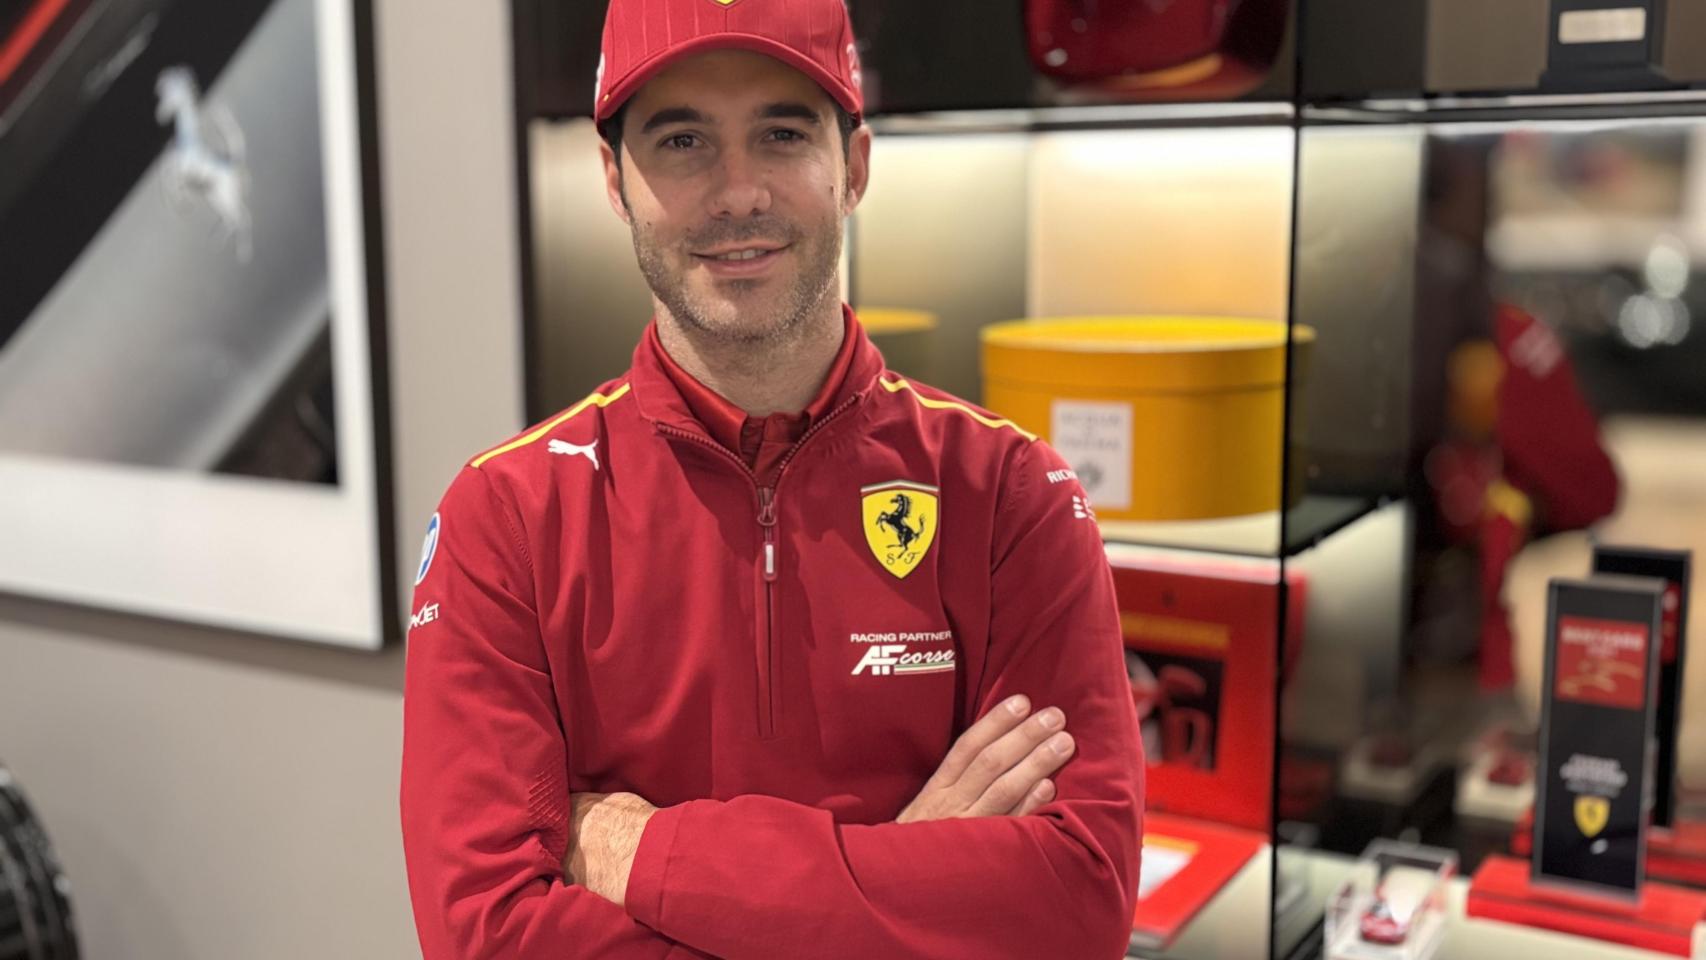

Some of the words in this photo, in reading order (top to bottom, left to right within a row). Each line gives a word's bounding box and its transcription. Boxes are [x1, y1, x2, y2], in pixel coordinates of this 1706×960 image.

[886, 553, 895, 565] S
[850, 632, 897, 642] RACING
[899, 630, 952, 642] PARTNER
[850, 644, 907, 676] AF
[899, 649, 955, 665] corse
